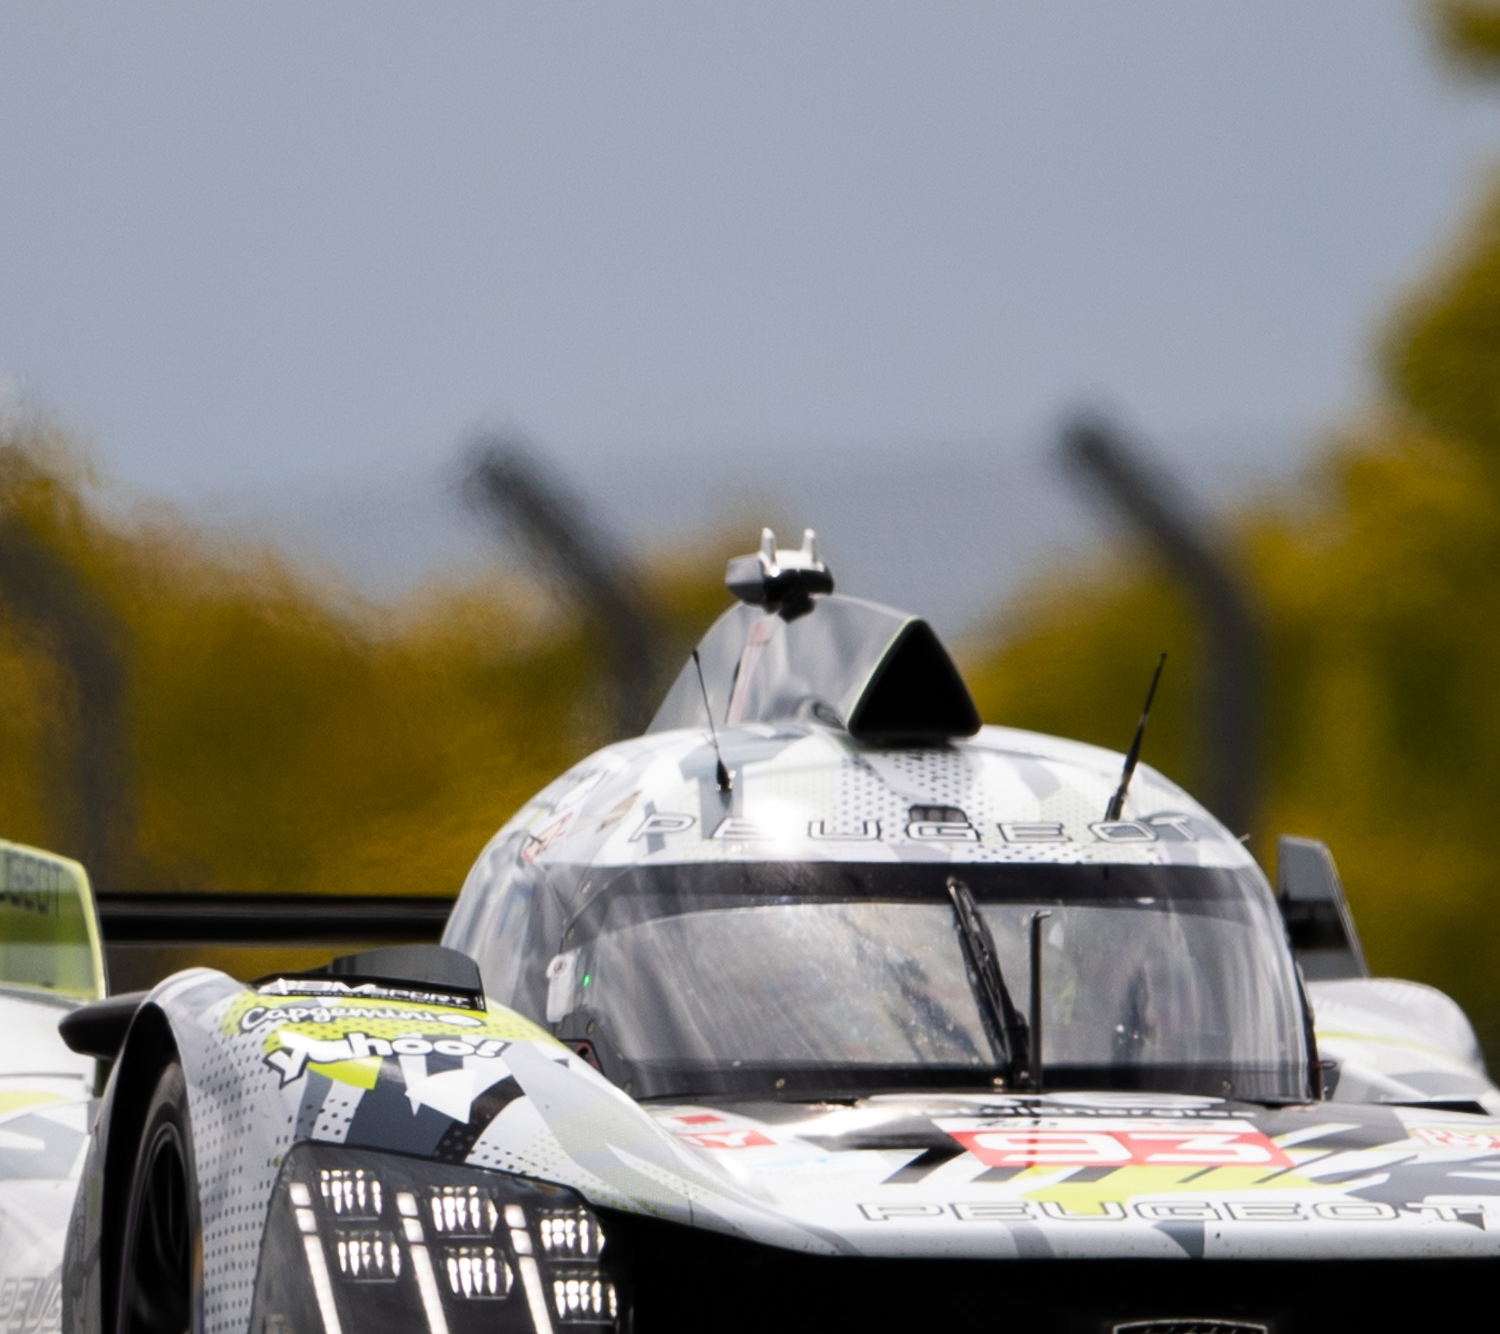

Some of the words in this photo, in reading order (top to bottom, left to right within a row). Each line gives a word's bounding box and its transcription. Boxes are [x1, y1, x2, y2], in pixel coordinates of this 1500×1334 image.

[630, 813, 1198, 843] PEUGEOT
[239, 1006, 434, 1033] Capgemini
[263, 1031, 510, 1089] yahoo!
[972, 1132, 1272, 1163] 93
[857, 1201, 1486, 1222] PEUGEOT
